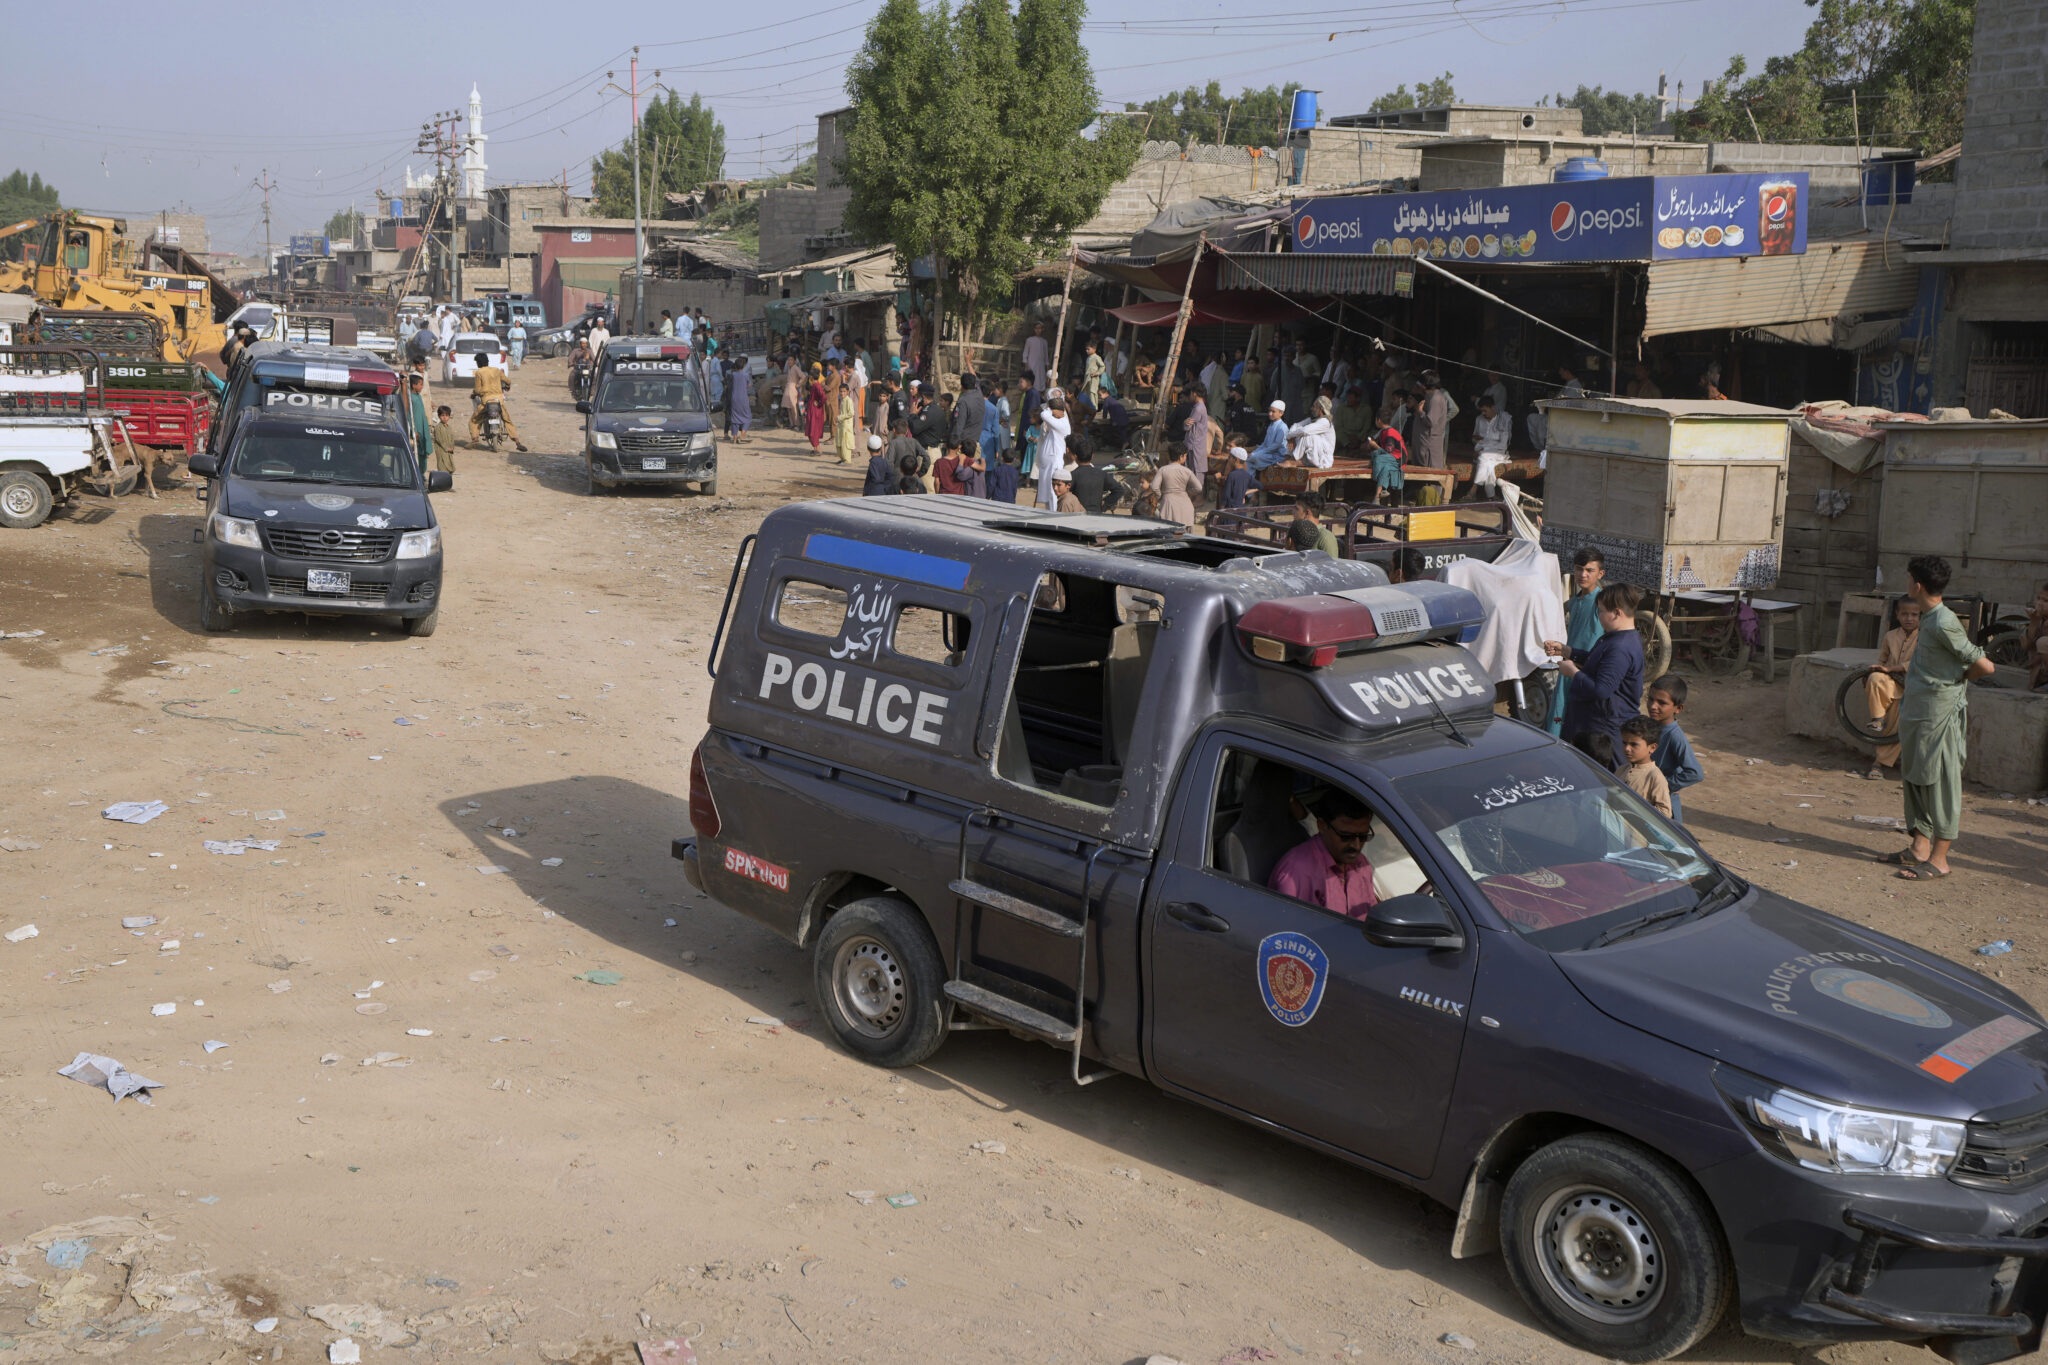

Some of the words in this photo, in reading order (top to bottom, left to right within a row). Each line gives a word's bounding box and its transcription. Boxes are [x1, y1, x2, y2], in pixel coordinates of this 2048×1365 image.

[1318, 216, 1361, 244] pepsi
[1579, 202, 1641, 236] pepsi
[1768, 222, 1785, 231] pepsi
[150, 277, 168, 290] CAT
[512, 316, 543, 324] POLICE
[616, 362, 683, 371] POLICE
[266, 392, 383, 416] POLICE
[759, 652, 949, 746] POLICE
[1349, 662, 1486, 715] POLICE
[1275, 940, 1317, 961] SINDH
[1765, 961, 1807, 1015] POLICE
[1795, 951, 1905, 968] PATROL
[1271, 1003, 1307, 1022] POLICE
[1399, 986, 1465, 1017] HILUX
